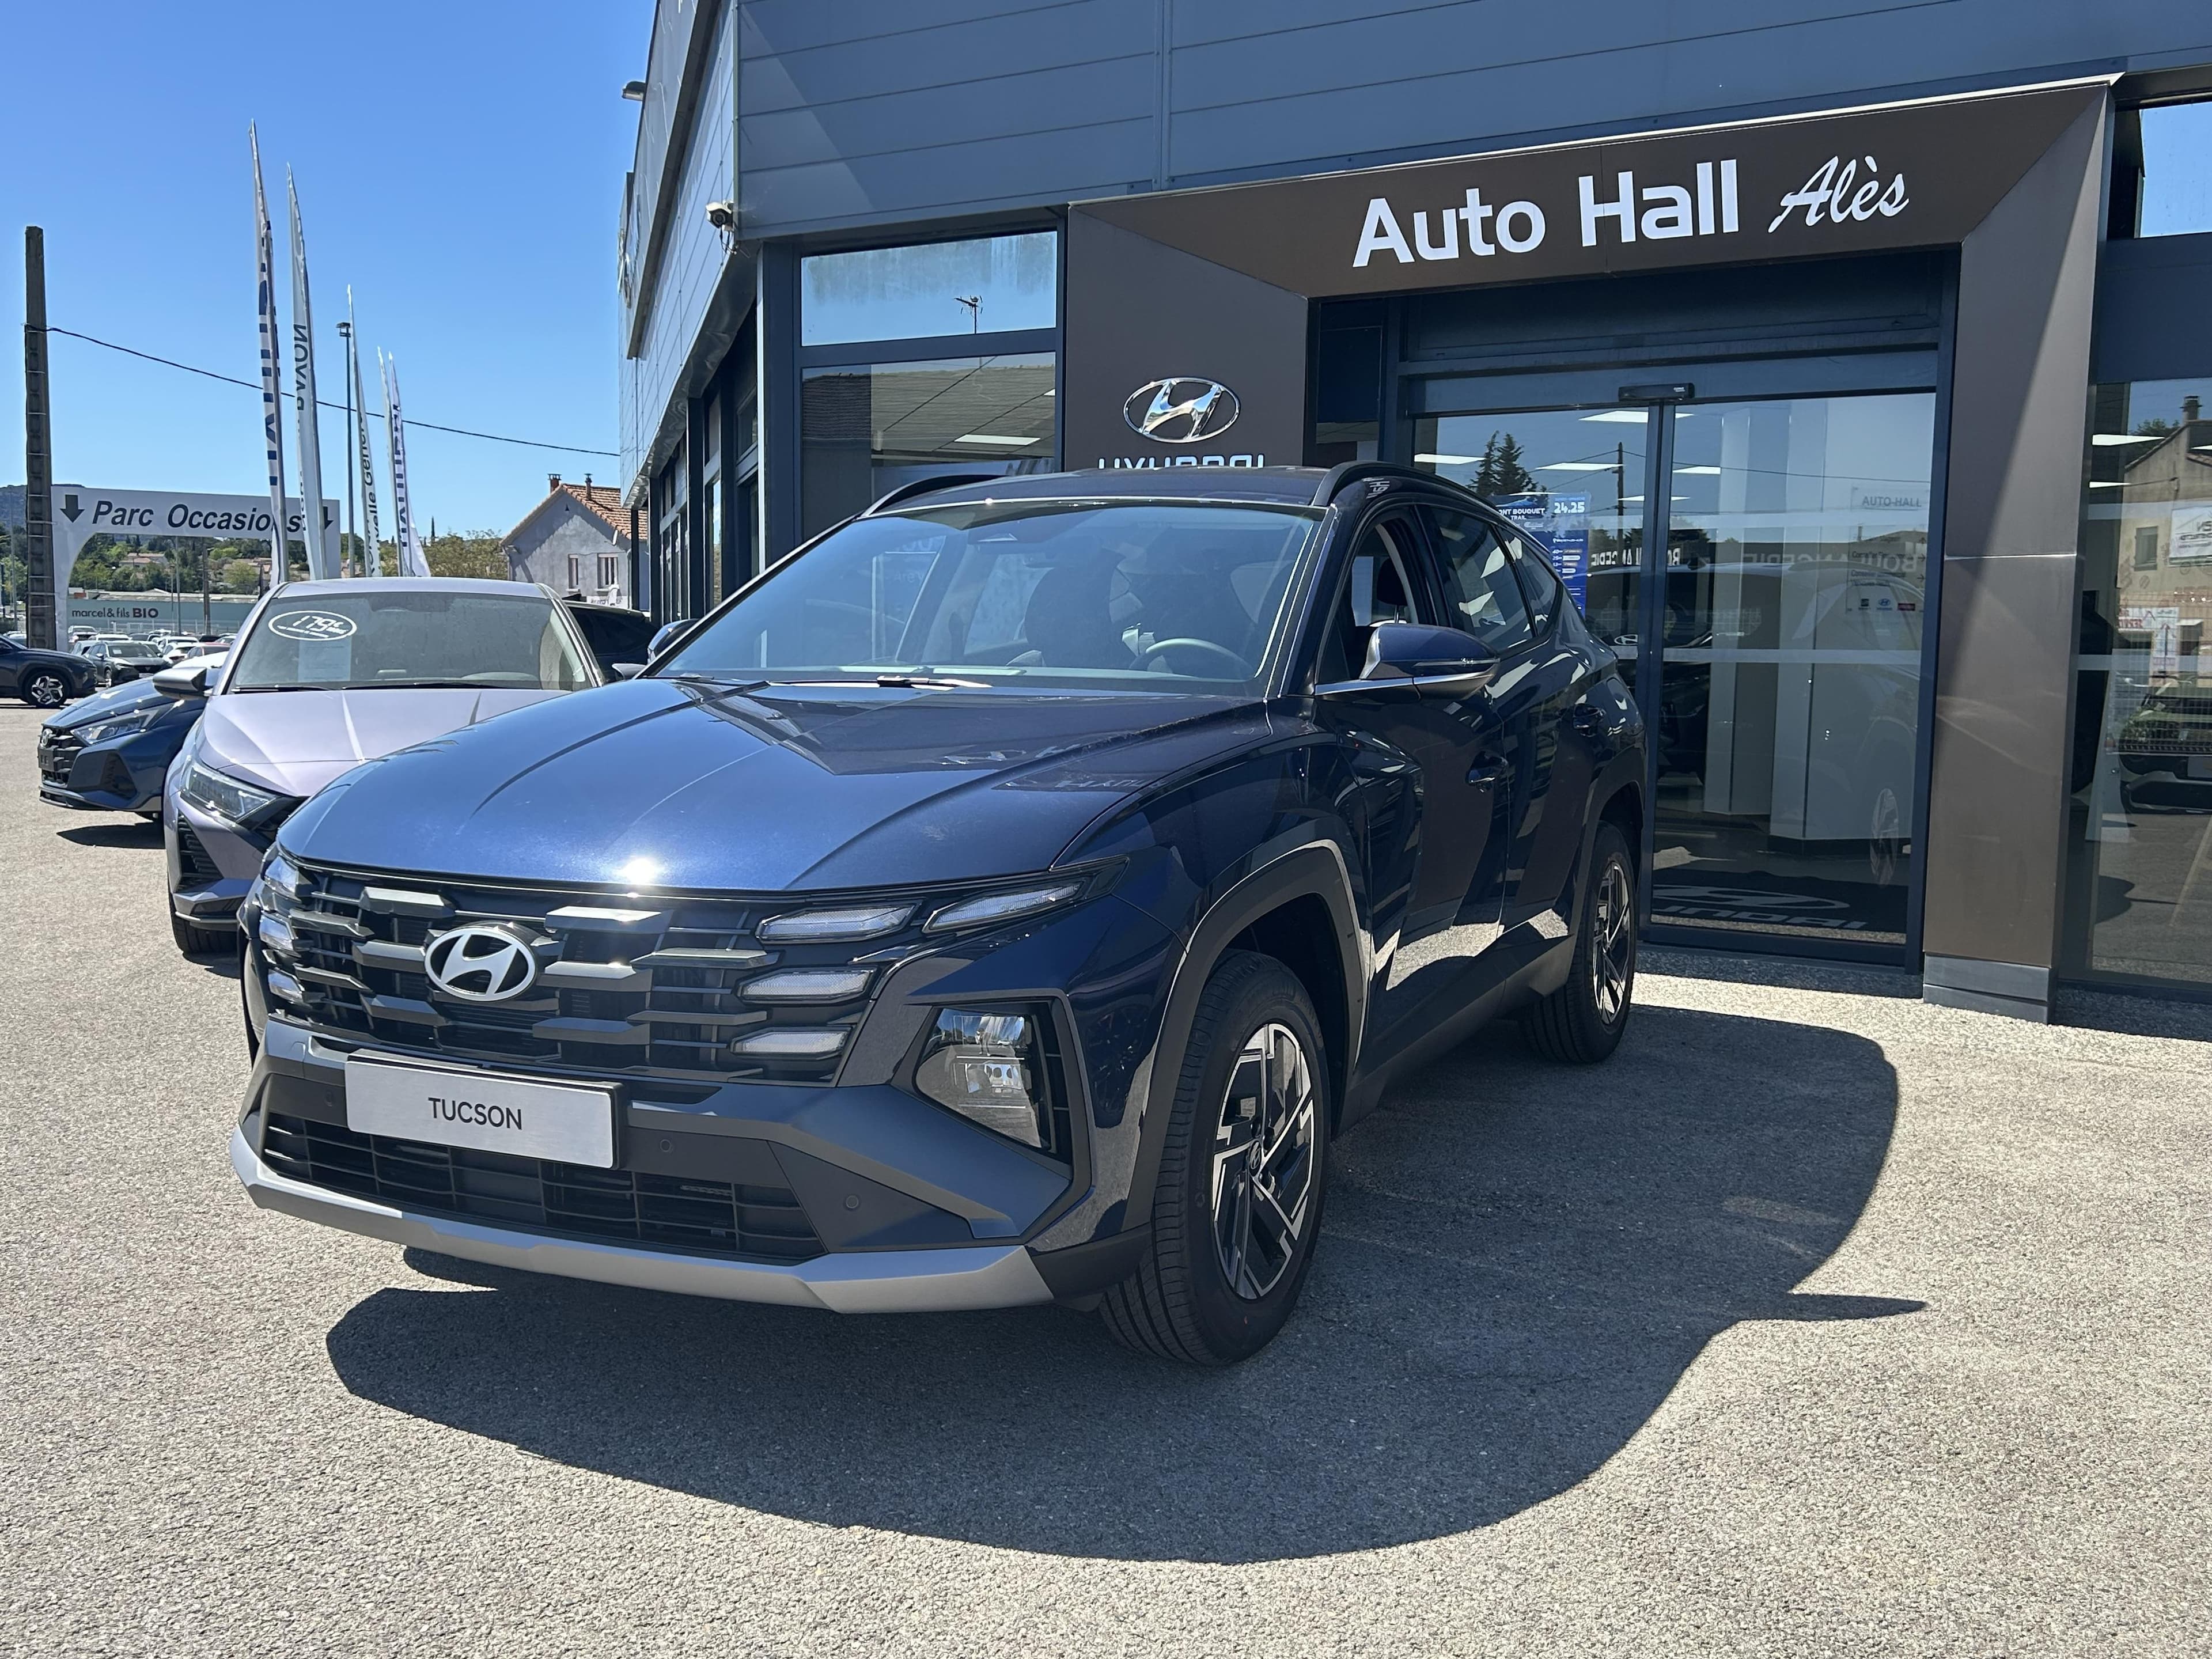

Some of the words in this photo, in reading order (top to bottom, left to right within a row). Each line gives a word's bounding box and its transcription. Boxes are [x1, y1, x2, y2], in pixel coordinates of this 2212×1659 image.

[1353, 188, 1546, 267] Auto
[1578, 158, 1738, 247] Hall
[1767, 155, 1910, 233] Alès
[92, 500, 154, 527] Parc
[168, 503, 301, 533] Occasios
[132, 608, 158, 618] BIO
[427, 1097, 522, 1130] TUCSON
